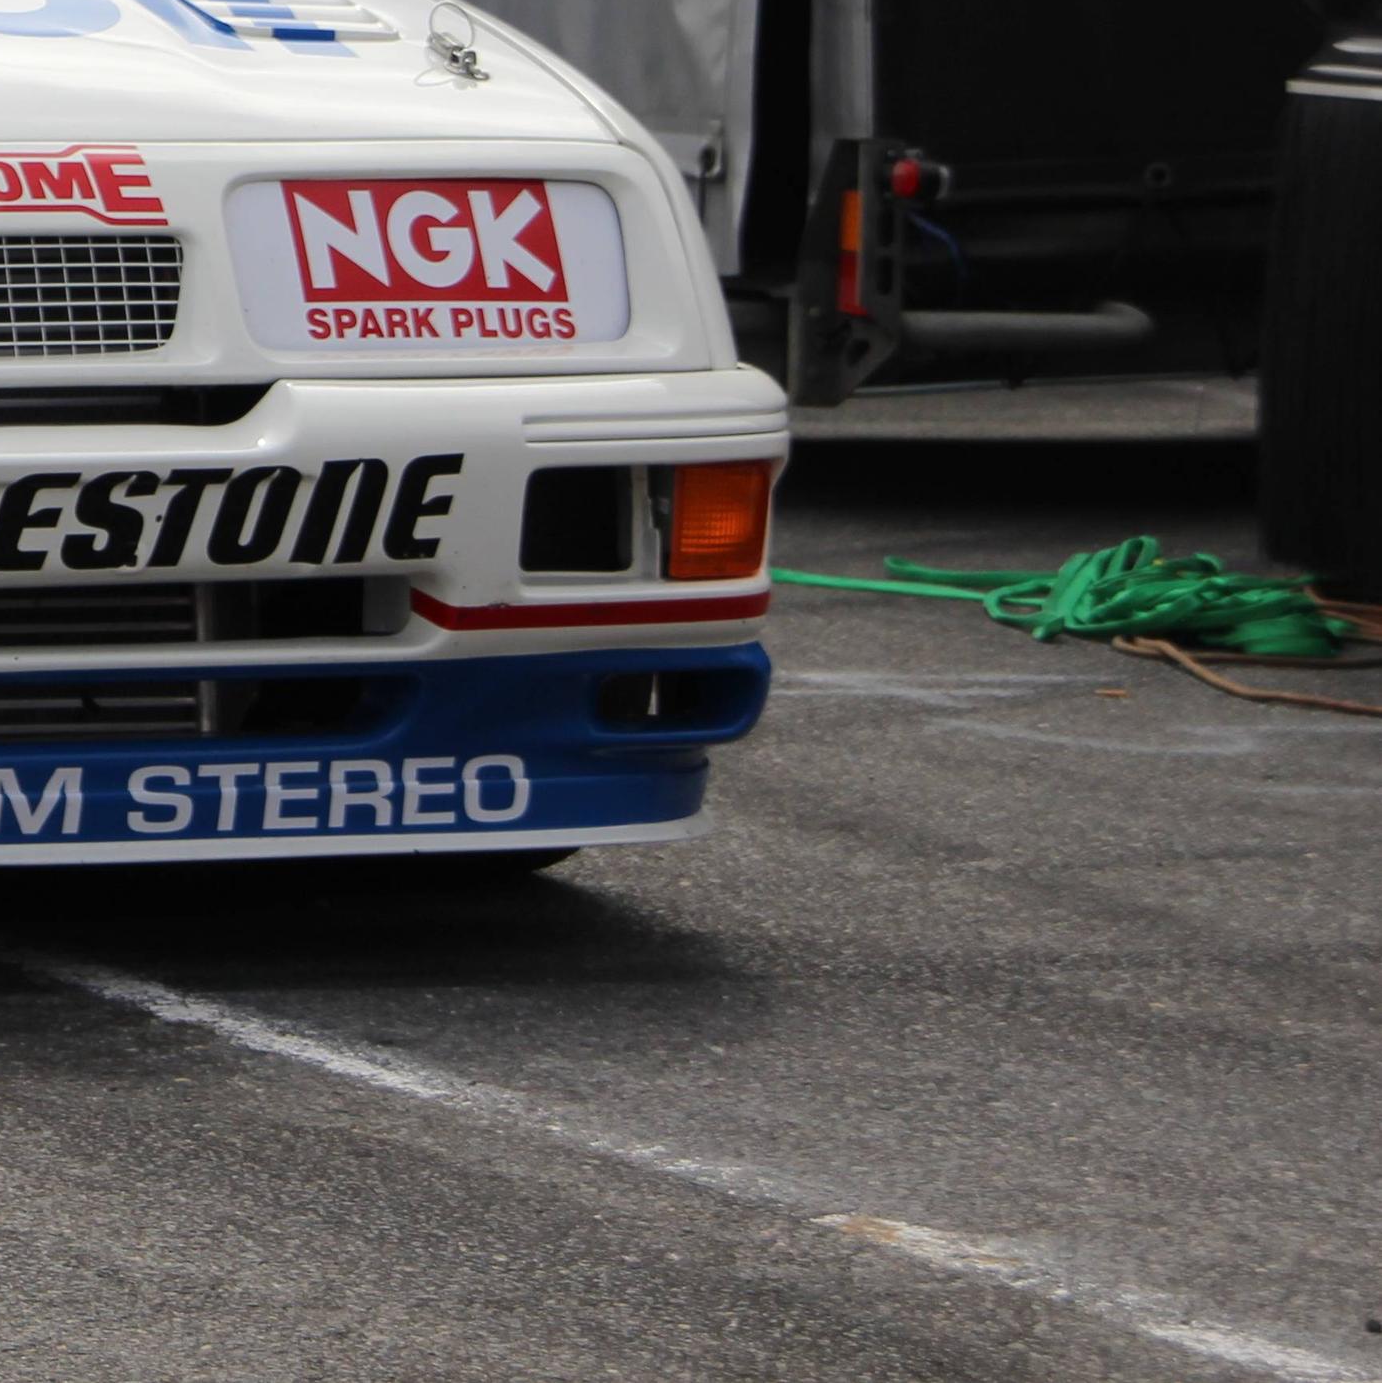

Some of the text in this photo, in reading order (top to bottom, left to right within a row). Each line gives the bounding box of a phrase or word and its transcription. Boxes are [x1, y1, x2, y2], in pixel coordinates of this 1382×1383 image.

[291, 188, 557, 294] NGK
[306, 307, 576, 340] SPARK PLUGS
[126, 753, 532, 834] STEREO
